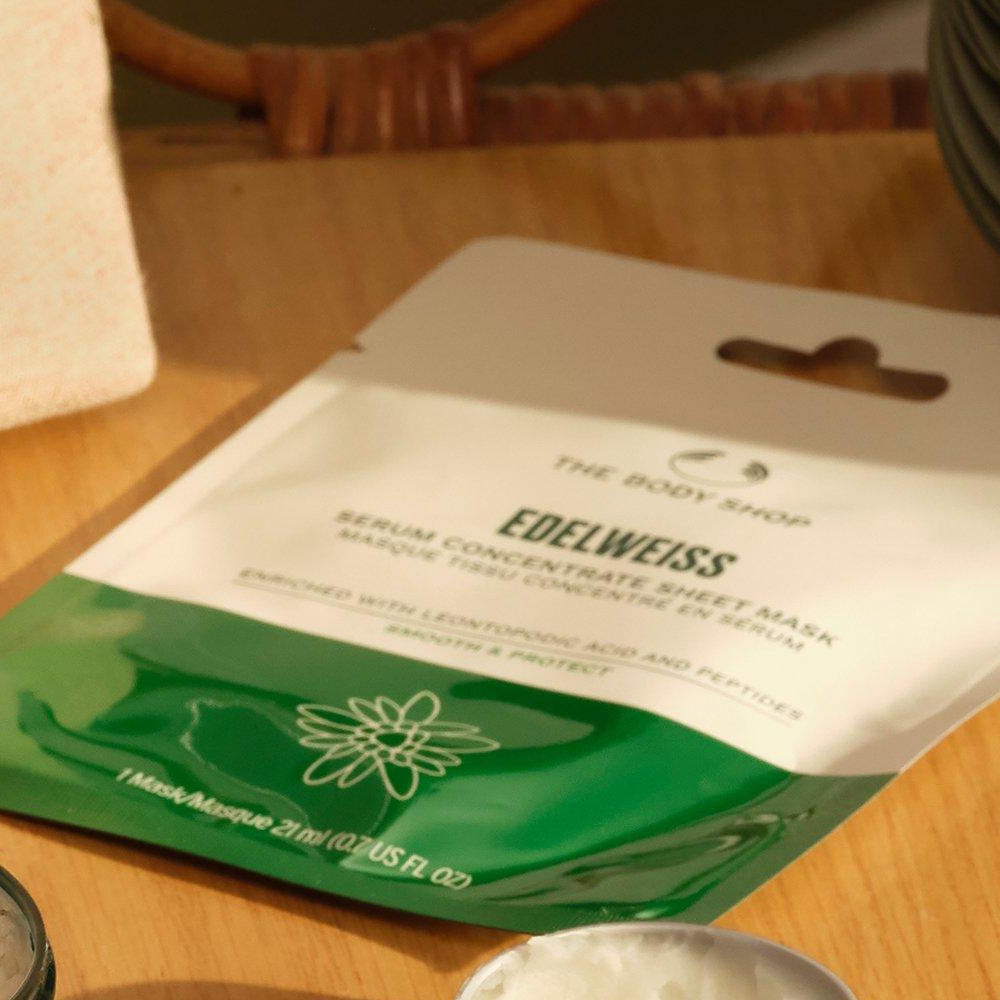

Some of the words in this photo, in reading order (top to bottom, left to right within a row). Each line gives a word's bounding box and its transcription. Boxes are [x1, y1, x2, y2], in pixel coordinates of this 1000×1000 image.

[553, 455, 618, 481] THE
[622, 471, 718, 503] BODY
[717, 497, 812, 528] SHOP
[333, 509, 438, 542] SERUM
[441, 535, 650, 589] CONCENTRATE
[656, 580, 752, 612] SHEET
[754, 605, 841, 648] MASK
[336, 527, 441, 563] MASQUE
[447, 554, 521, 581] TISSU
[676, 601, 714, 620] EN
[496, 506, 739, 579] EDELWEISS
[238, 566, 354, 600] ENRICHED
[358, 592, 418, 615] WITH
[583, 639, 639, 658] ACID
[640, 651, 692, 673] AND
[695, 665, 805, 722] PEPTIDES
[384, 623, 483, 652] SMOOTH
[508, 650, 615, 676] PROTECT
[128, 772, 276, 831] Mask/Masque
[270, 819, 300, 838] 21
[293, 828, 333, 846] ml
[366, 841, 406, 868] US
[400, 854, 430, 879] FL
[430, 867, 473, 891] OZ)
